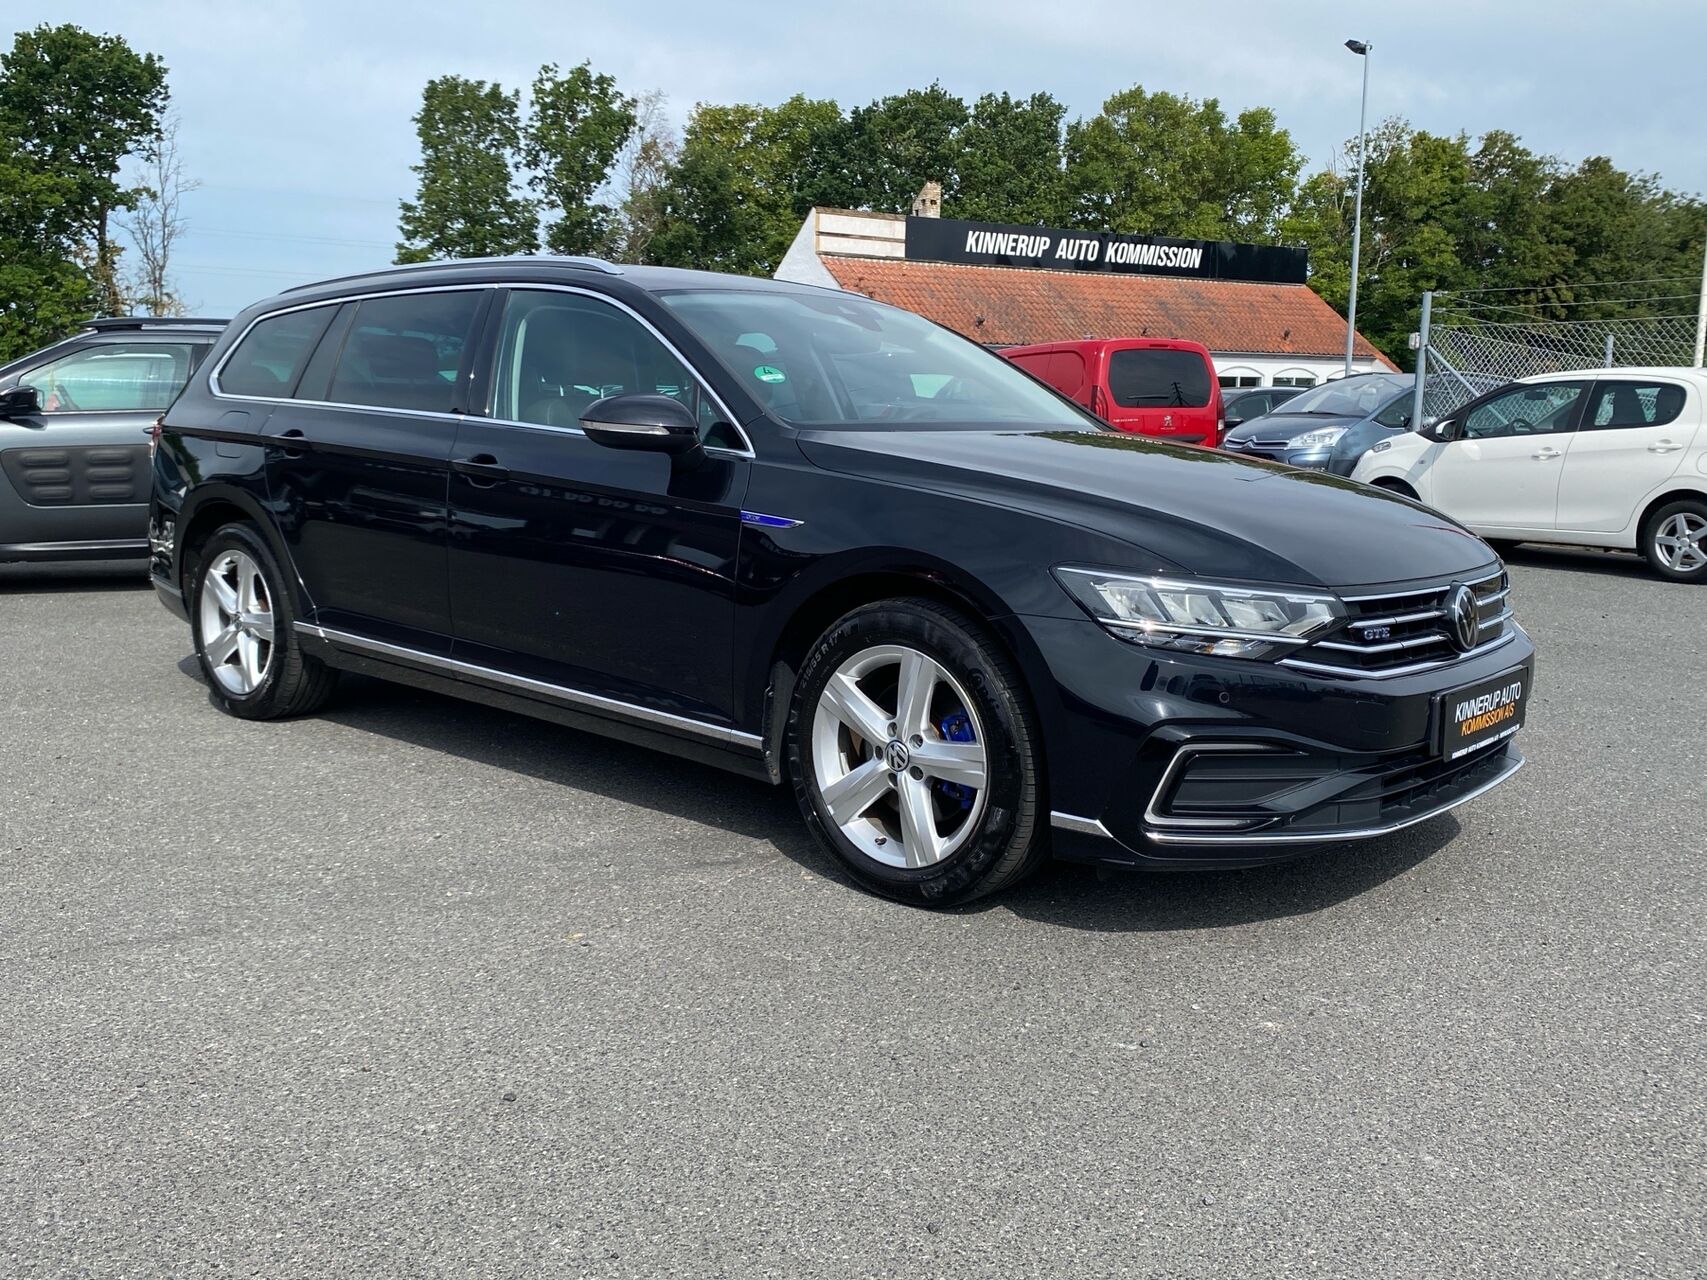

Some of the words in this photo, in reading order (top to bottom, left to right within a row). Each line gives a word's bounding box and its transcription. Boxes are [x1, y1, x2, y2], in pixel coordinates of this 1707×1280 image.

[965, 230, 1051, 258] KINNERUP
[1055, 238, 1100, 262] AUTO
[1105, 241, 1203, 269] KOMMISSION
[1364, 626, 1390, 641] GTE
[1455, 690, 1501, 723] KINNERUP
[1501, 681, 1522, 706] AUTO
[1461, 708, 1505, 737] KOMMISSION
[1503, 702, 1516, 721] A/S
